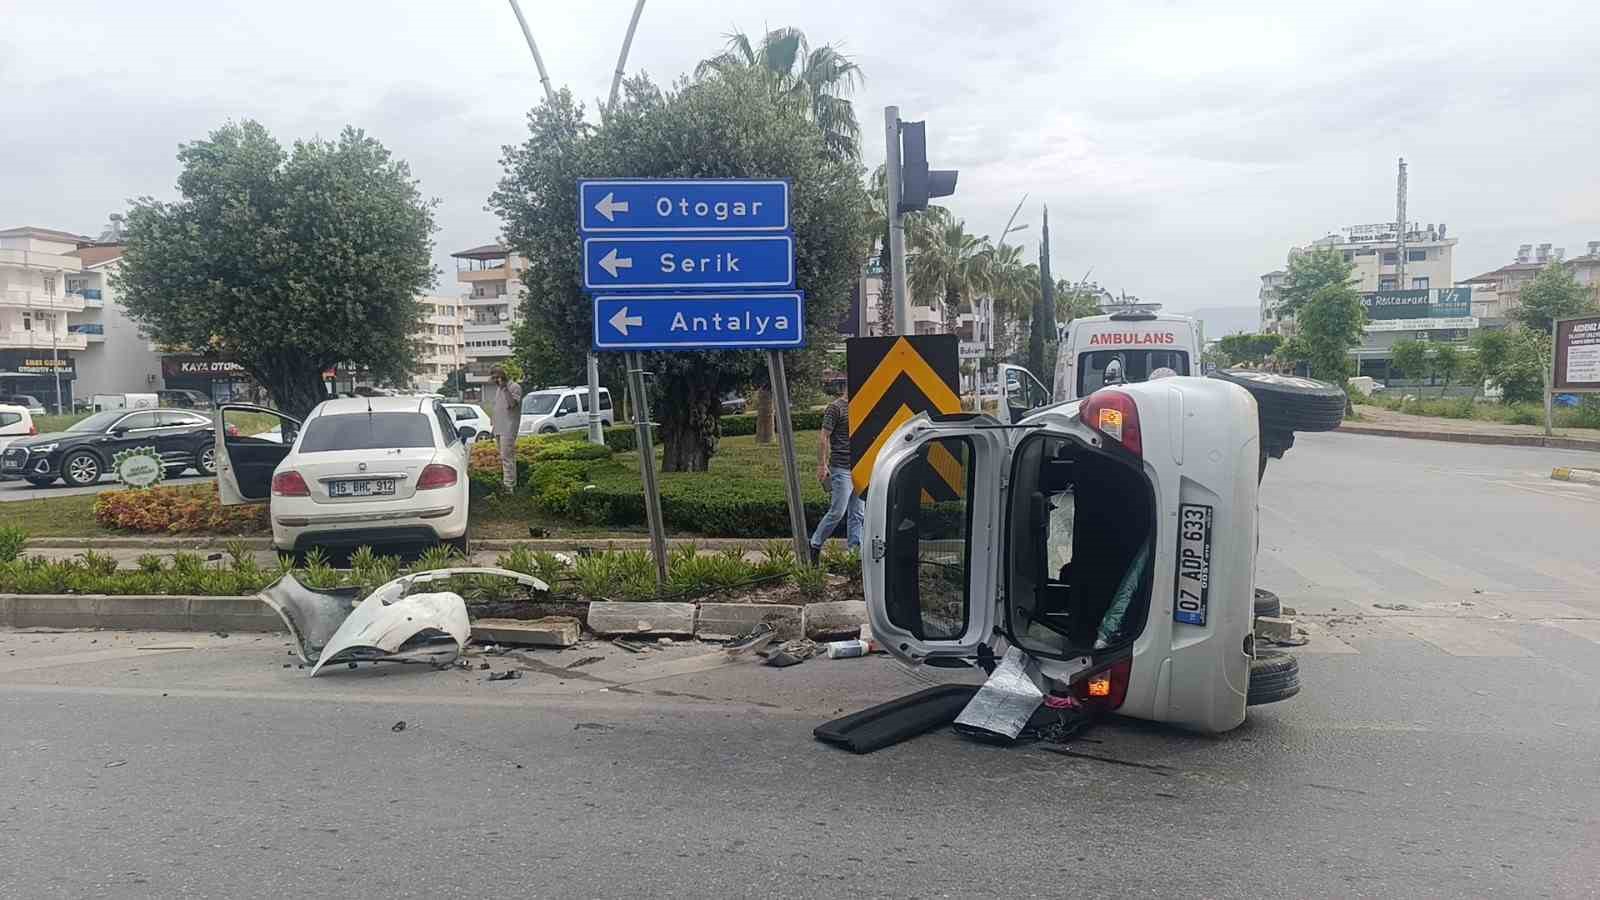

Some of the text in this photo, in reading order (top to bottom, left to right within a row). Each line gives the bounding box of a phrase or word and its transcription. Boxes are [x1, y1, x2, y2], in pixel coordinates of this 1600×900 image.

[656, 197, 763, 221] Otogar
[660, 252, 740, 273] Serik
[669, 311, 789, 335] Antalya
[1089, 332, 1175, 345] AMBULANS
[181, 362, 208, 372] KAYA
[336, 482, 347, 493] 16
[376, 479, 394, 491] 912
[1179, 509, 1204, 612] 07 ADP 633
